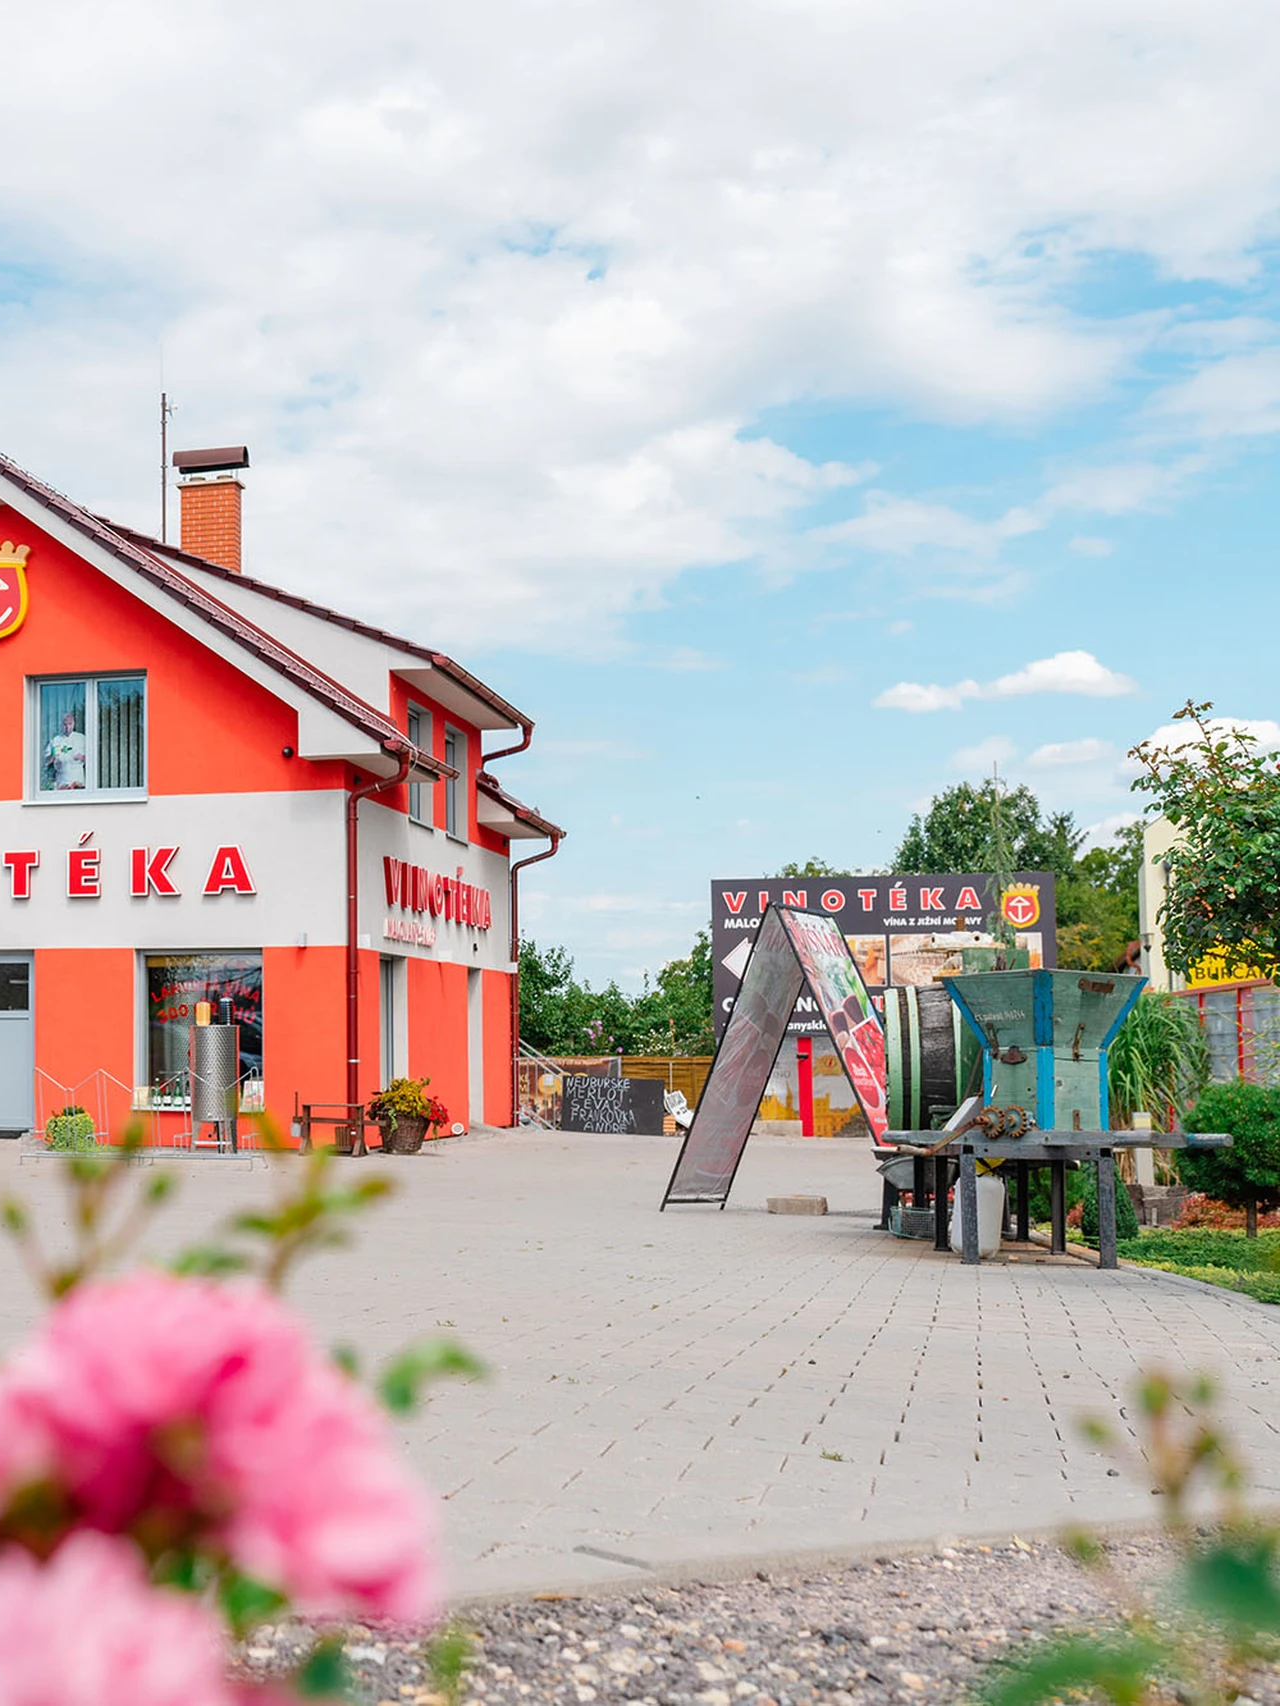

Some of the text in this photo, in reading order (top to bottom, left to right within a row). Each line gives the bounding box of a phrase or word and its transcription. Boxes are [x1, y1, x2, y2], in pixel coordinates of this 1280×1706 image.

[383, 856, 492, 930] VINOTÉKA
[722, 882, 982, 914] VINOTÉKA
[724, 917, 761, 930] MALO
[943, 917, 982, 925] MOAVY
[157, 1003, 189, 1024] 300
[566, 1087, 628, 1103] MERLOT
